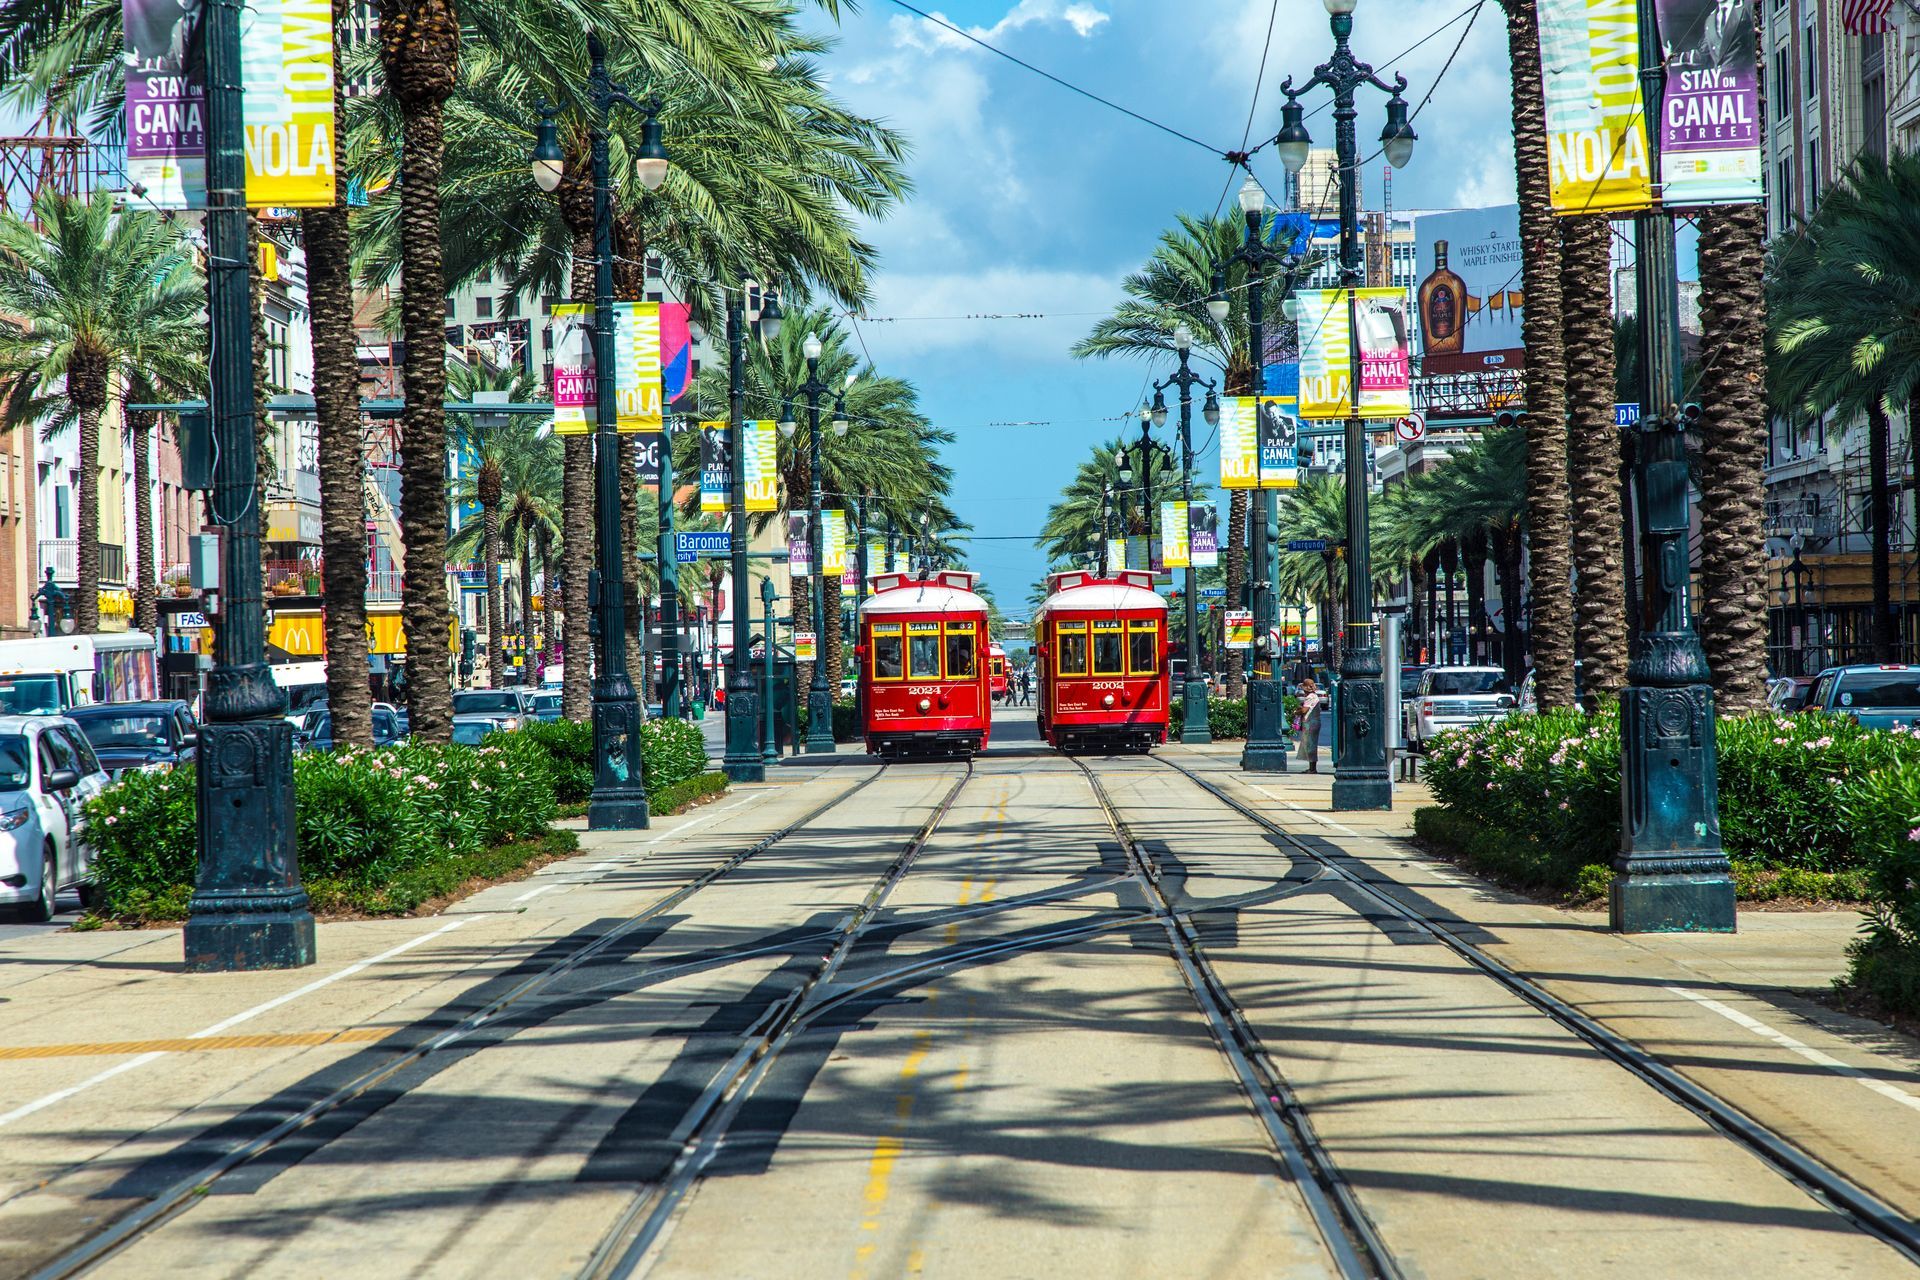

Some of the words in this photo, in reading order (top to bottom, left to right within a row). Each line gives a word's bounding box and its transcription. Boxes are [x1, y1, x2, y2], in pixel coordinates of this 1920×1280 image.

[147, 77, 187, 97] STAY
[190, 85, 202, 95] ON
[1680, 68, 1721, 91] STAY
[1723, 76, 1736, 88] ON
[134, 104, 203, 134] CANA
[1668, 94, 1752, 128] CANAL
[136, 135, 202, 146] STREE
[1670, 125, 1752, 141] STREET
[244, 124, 333, 176] NOLA
[1549, 125, 1649, 185] NOLA
[1459, 245, 1491, 257] WHISKY
[1492, 241, 1520, 253] STARTE
[1463, 256, 1487, 267] MAPLE
[1489, 252, 1523, 264] FINISHED
[1322, 304, 1350, 375] TOWN
[633, 316, 660, 383] TOWN
[1366, 347, 1390, 359] SHOP
[562, 364, 588, 375] SHOP
[1362, 361, 1404, 378] CANAL
[1300, 375, 1351, 404] NOLA
[616, 388, 662, 416] NOLA
[1616, 406, 1639, 424] phi
[1267, 438, 1284, 447] PLAY
[1263, 448, 1295, 460] CANAL
[708, 463, 724, 471] PLAY
[1221, 457, 1256, 478] NOLA
[744, 480, 776, 500] NOLA
[680, 534, 729, 549] Baronne
[1192, 538, 1215, 546] CANAL
[677, 552, 691, 561] rsity
[1163, 544, 1188, 560] NOLA
[181, 614, 207, 625] FAS
[908, 687, 941, 695] 2024
[1092, 682, 1124, 690] 2002
